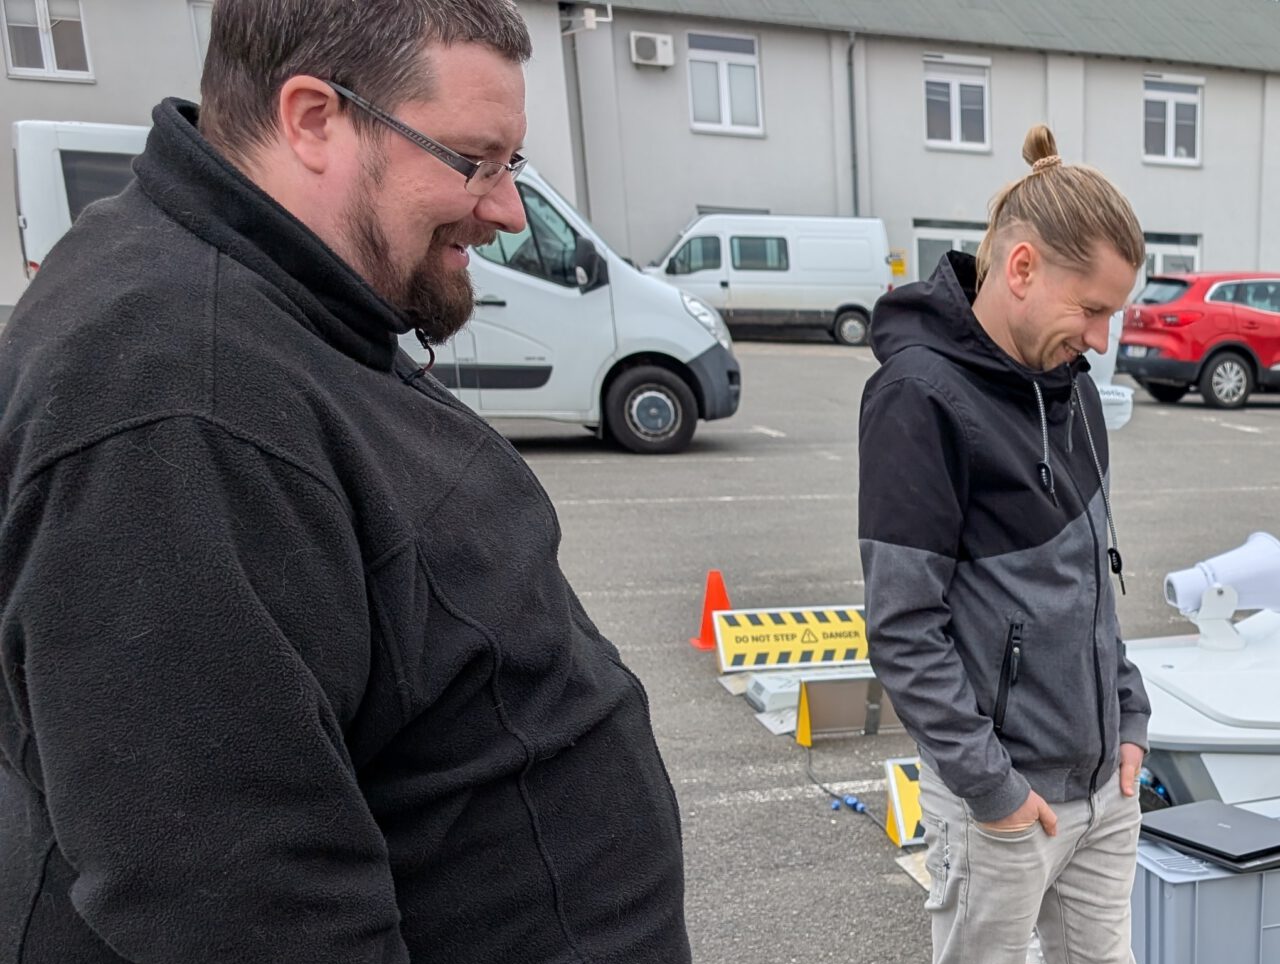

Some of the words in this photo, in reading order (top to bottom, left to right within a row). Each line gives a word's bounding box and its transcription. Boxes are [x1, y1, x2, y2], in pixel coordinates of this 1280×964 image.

[735, 635, 749, 644] DO
[751, 634, 771, 643] NOT
[773, 633, 797, 642] STEP
[822, 630, 860, 640] DANGER
